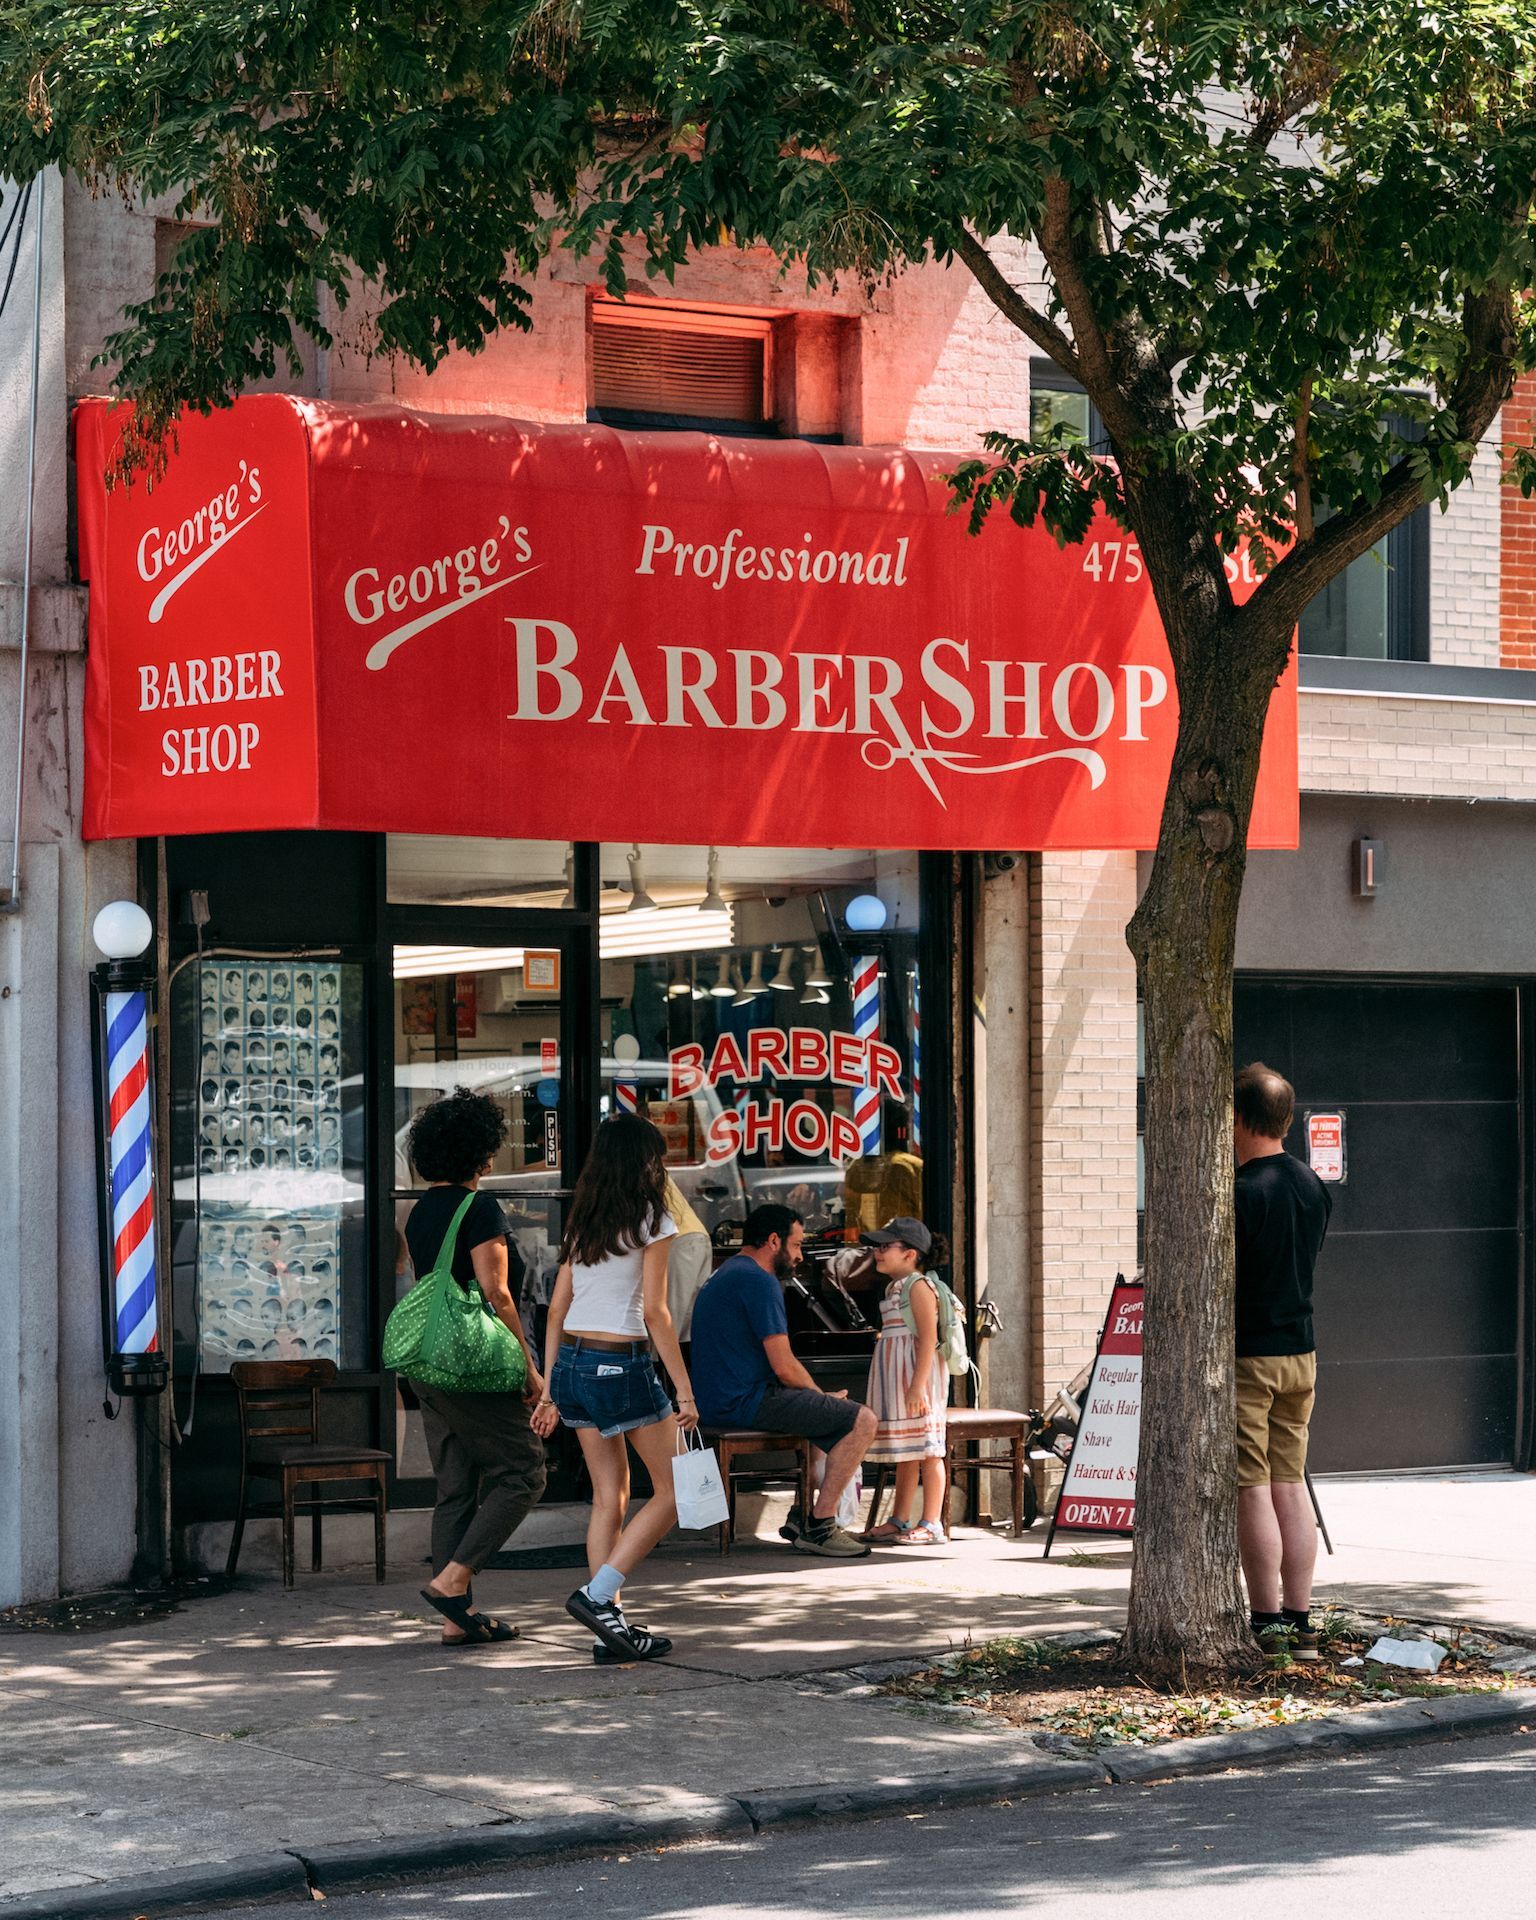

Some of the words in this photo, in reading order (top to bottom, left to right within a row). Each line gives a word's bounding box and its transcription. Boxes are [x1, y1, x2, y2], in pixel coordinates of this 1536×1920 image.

[136, 458, 262, 583] George's
[344, 515, 533, 626] George's
[635, 524, 910, 591] Professional
[1082, 541, 1143, 583] 475
[137, 649, 285, 713] BARBER
[161, 721, 261, 778] SHOP
[668, 1026, 906, 1104] BARBER
[547, 1116, 556, 1163] PUSH
[705, 1098, 864, 1168] SHOP
[1119, 1301, 1144, 1315] Geor
[1098, 1366, 1139, 1387] Regular
[1090, 1399, 1116, 1416] Kids
[1115, 1400, 1140, 1416] Hair
[1082, 1431, 1113, 1448] Shave
[1073, 1463, 1114, 1480] Haircut
[1116, 1465, 1127, 1481] &
[1127, 1466, 1138, 1482] S
[1064, 1503, 1114, 1525] OPEN
[1115, 1507, 1127, 1526] 7
